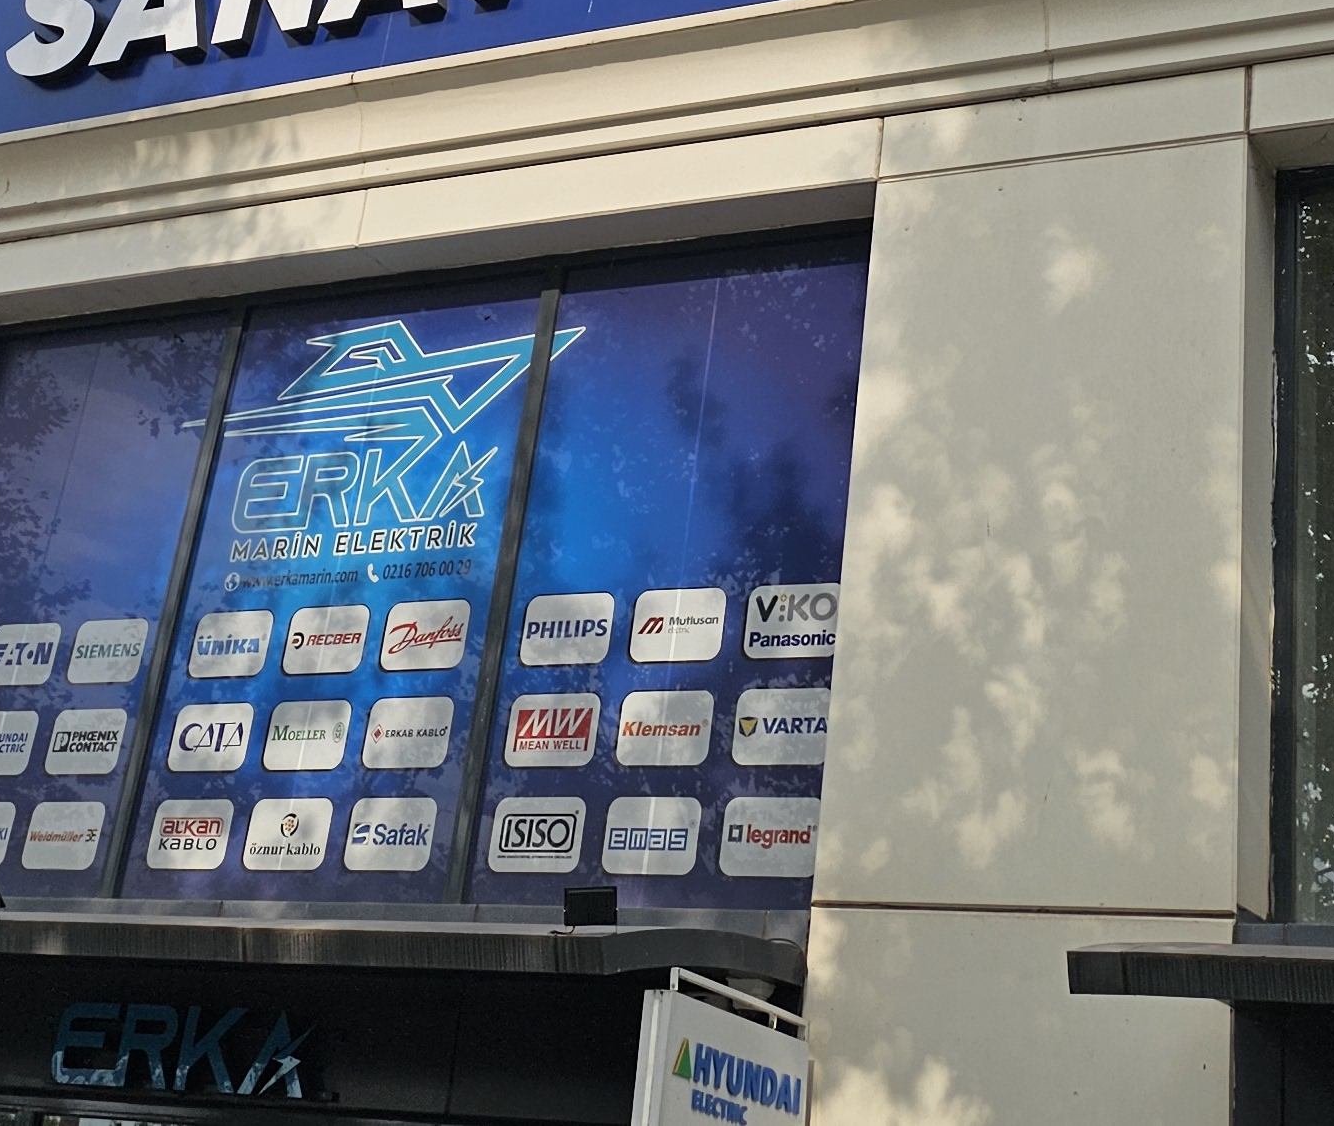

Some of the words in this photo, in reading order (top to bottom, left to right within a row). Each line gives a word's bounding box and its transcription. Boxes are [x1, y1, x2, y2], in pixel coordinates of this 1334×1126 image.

[232, 440, 498, 534] ERKA
[230, 530, 322, 563] MARİN
[333, 520, 478, 556] ELEKTRİK
[383, 563, 412, 580] 0216
[416, 561, 436, 578] 706
[439, 560, 454, 576] 00
[525, 618, 608, 639] PHILIPS
[669, 616, 719, 626] Mutlusan
[388, 615, 464, 656] Danfoss
[749, 629, 836, 648] Panasonic
[74, 642, 142, 660] SIEMENS
[385, 729, 414, 738] ERKAB
[416, 728, 446, 737] KABLO
[622, 721, 701, 737] Klemsan
[762, 717, 828, 735] VARTA
[178, 721, 245, 753] CATA
[519, 739, 550, 751] MEAN
[553, 738, 582, 750] WELL
[68, 741, 118, 753] CONTACT
[29, 829, 84, 842] Weidmüller
[746, 823, 812, 850] legrand
[249, 844, 285, 857] öznur
[285, 842, 321, 856] kablo
[51, 1001, 317, 1099] ERKA
[693, 1042, 802, 1115] HYUNDAI
[691, 1089, 748, 1126] ELECTRIC
